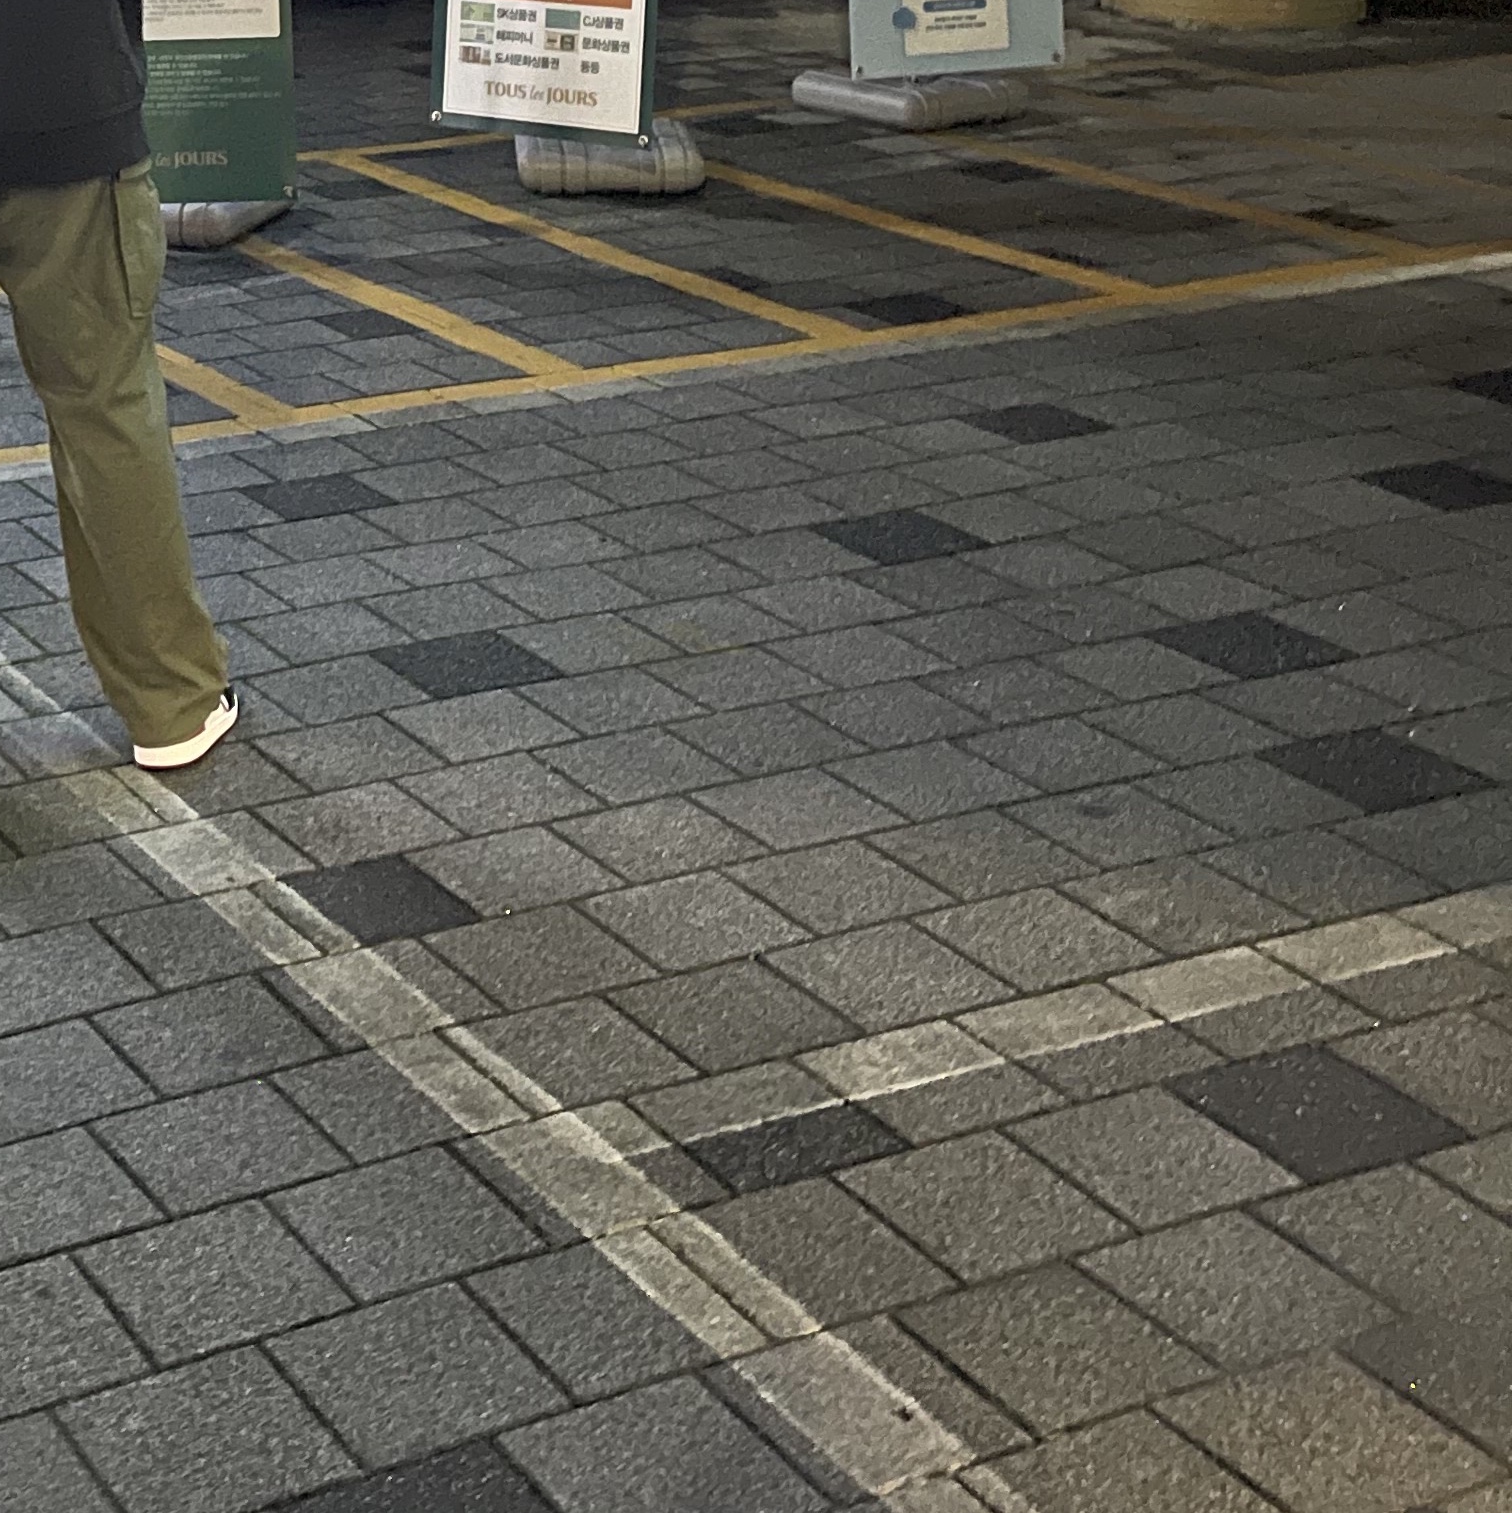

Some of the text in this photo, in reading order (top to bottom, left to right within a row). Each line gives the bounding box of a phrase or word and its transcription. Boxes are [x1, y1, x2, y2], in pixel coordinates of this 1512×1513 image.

[484, 80, 528, 100] TOUS
[545, 88, 599, 108] JOURS
[174, 149, 229, 169] JOURS
